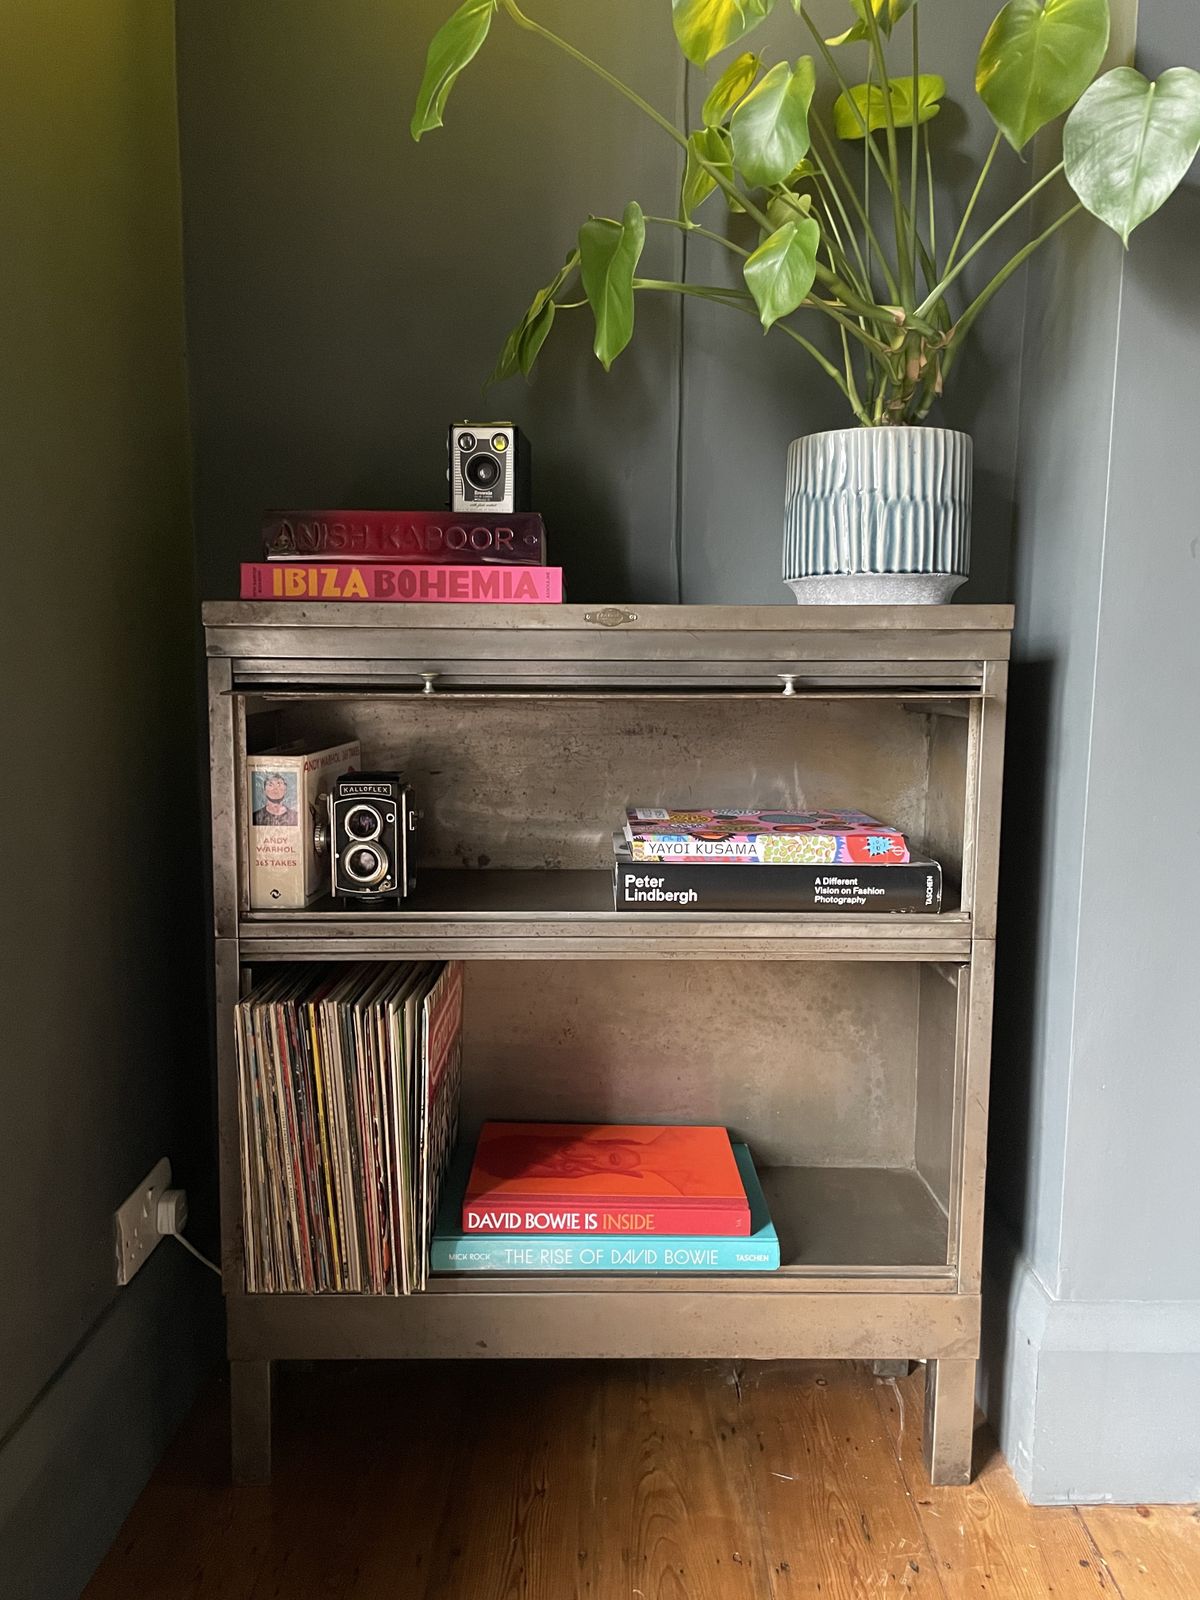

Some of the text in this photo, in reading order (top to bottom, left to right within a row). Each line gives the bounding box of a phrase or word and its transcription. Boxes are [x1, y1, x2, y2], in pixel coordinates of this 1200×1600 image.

[268, 520, 515, 550] ANISH KAPOOR
[272, 567, 369, 598] IBIZA
[374, 569, 541, 600] BOHEMIA
[648, 843, 757, 855] YAYOI KUSAMA
[625, 875, 665, 887] Peter
[823, 877, 857, 885] Different
[625, 889, 698, 904] Lindbergh
[925, 876, 933, 905] TASCHEN
[815, 895, 866, 904] Photography
[468, 1213, 655, 1230] DAVID BOWIE IS INSIDE
[505, 1249, 718, 1265] THE RISE OF DAVID BOWIE
[736, 1254, 768, 1262] TASCHEN
